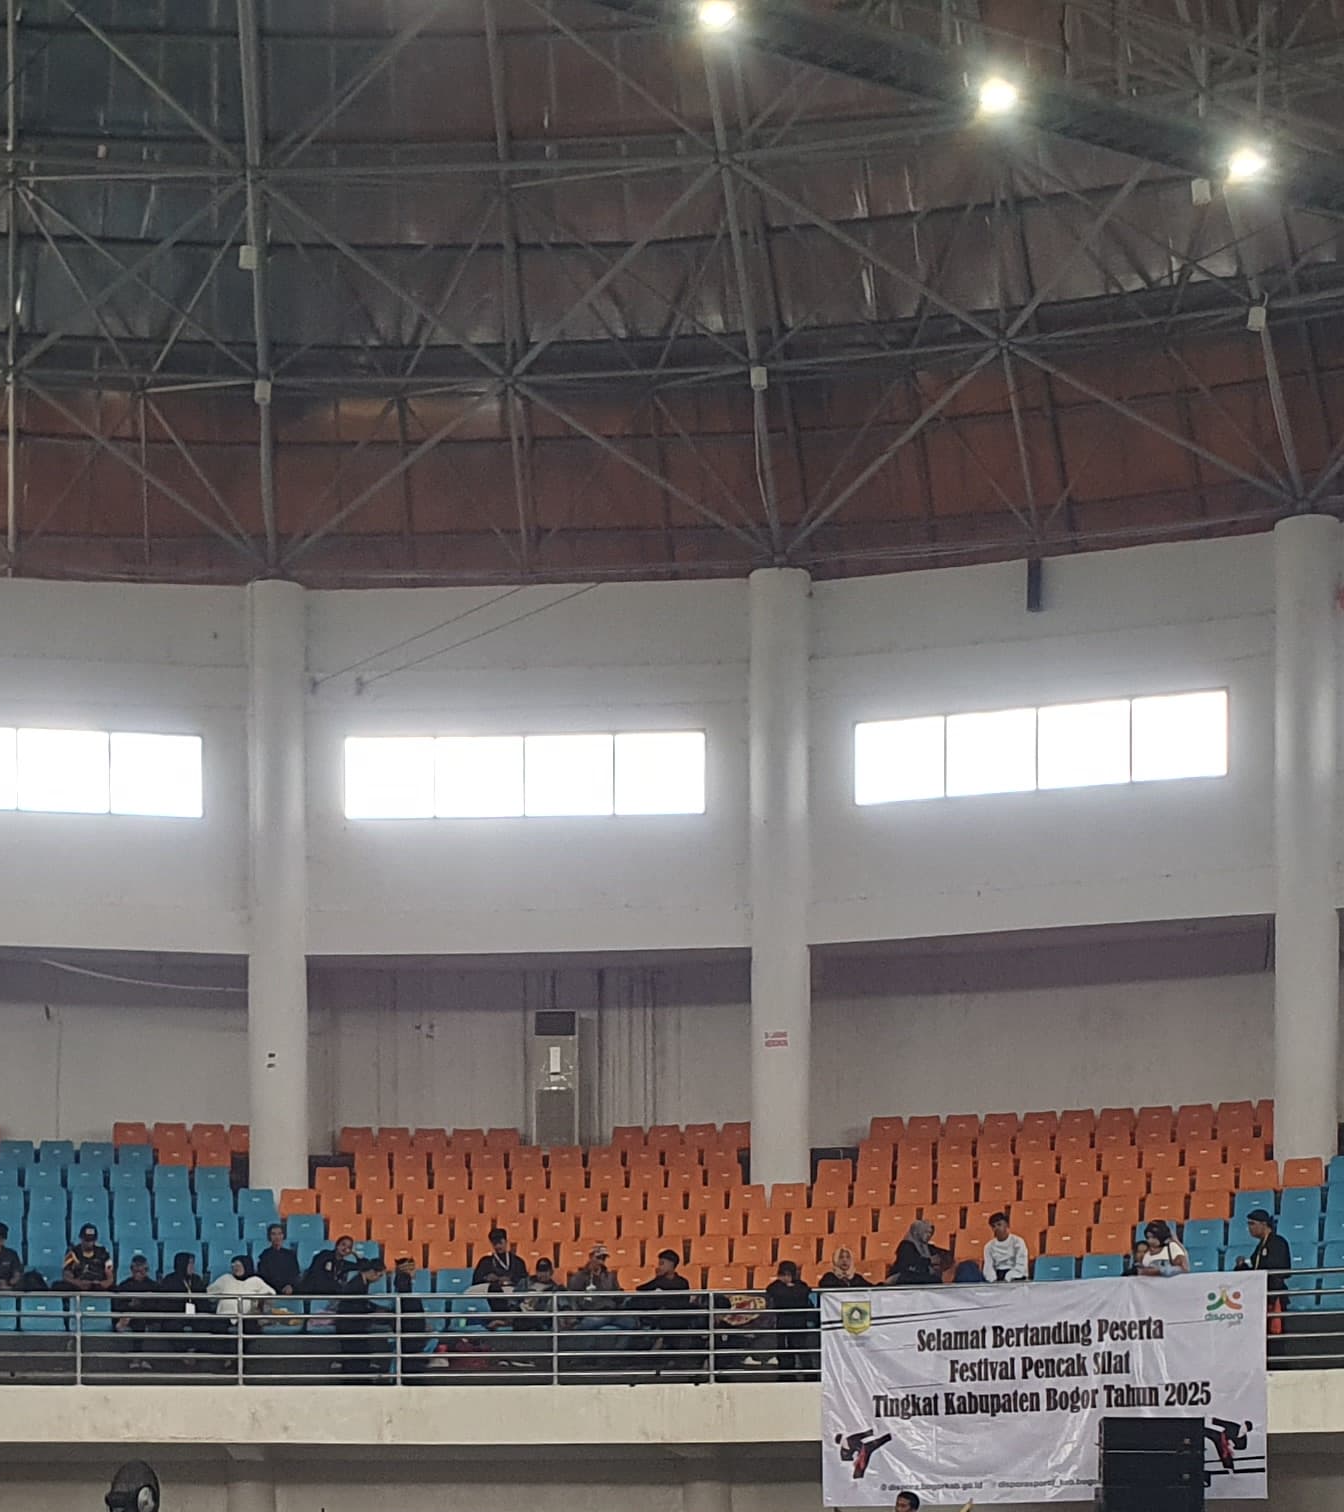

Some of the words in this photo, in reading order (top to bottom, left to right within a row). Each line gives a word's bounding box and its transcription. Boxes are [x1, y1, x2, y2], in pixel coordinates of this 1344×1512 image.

[917, 1325, 986, 1351] Selamat
[992, 1319, 1092, 1349] Bertanding
[1097, 1316, 1164, 1342] Peserta
[1205, 1311, 1244, 1322] dispora
[949, 1357, 1016, 1383] Festival
[1021, 1353, 1088, 1380] Pencak
[1093, 1350, 1130, 1375] Silat
[872, 1392, 939, 1420] Tingkat
[944, 1389, 1041, 1417] Kabupaten
[1046, 1387, 1099, 1413] Bogor
[1103, 1384, 1159, 1408] Tahun
[1164, 1381, 1212, 1407] 2025
